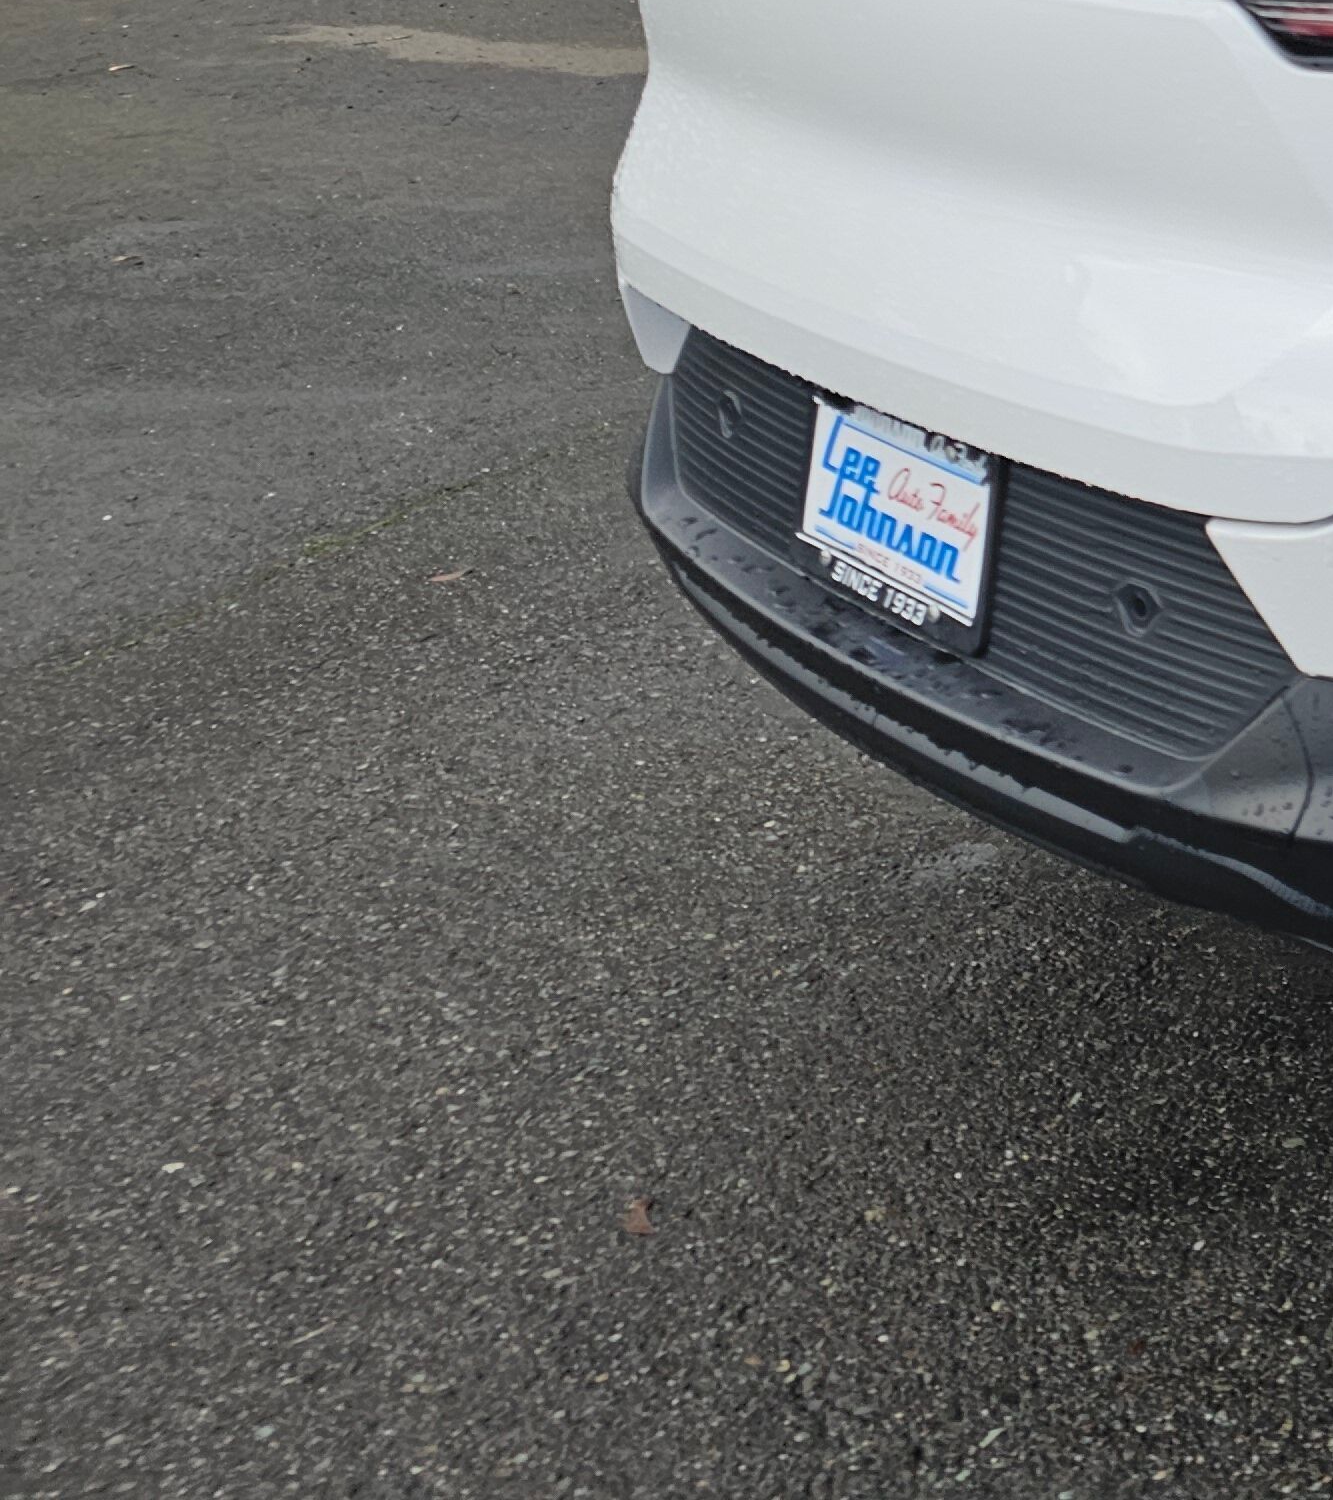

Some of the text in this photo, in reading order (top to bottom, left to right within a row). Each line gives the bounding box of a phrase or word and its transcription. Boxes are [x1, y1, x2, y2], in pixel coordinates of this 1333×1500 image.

[823, 414, 880, 494] Lee
[888, 468, 924, 512] Auto
[927, 483, 981, 552] Family
[819, 474, 961, 584] Johnson
[855, 543, 889, 568] SINCE
[831, 561, 927, 626] SINCE 1933
